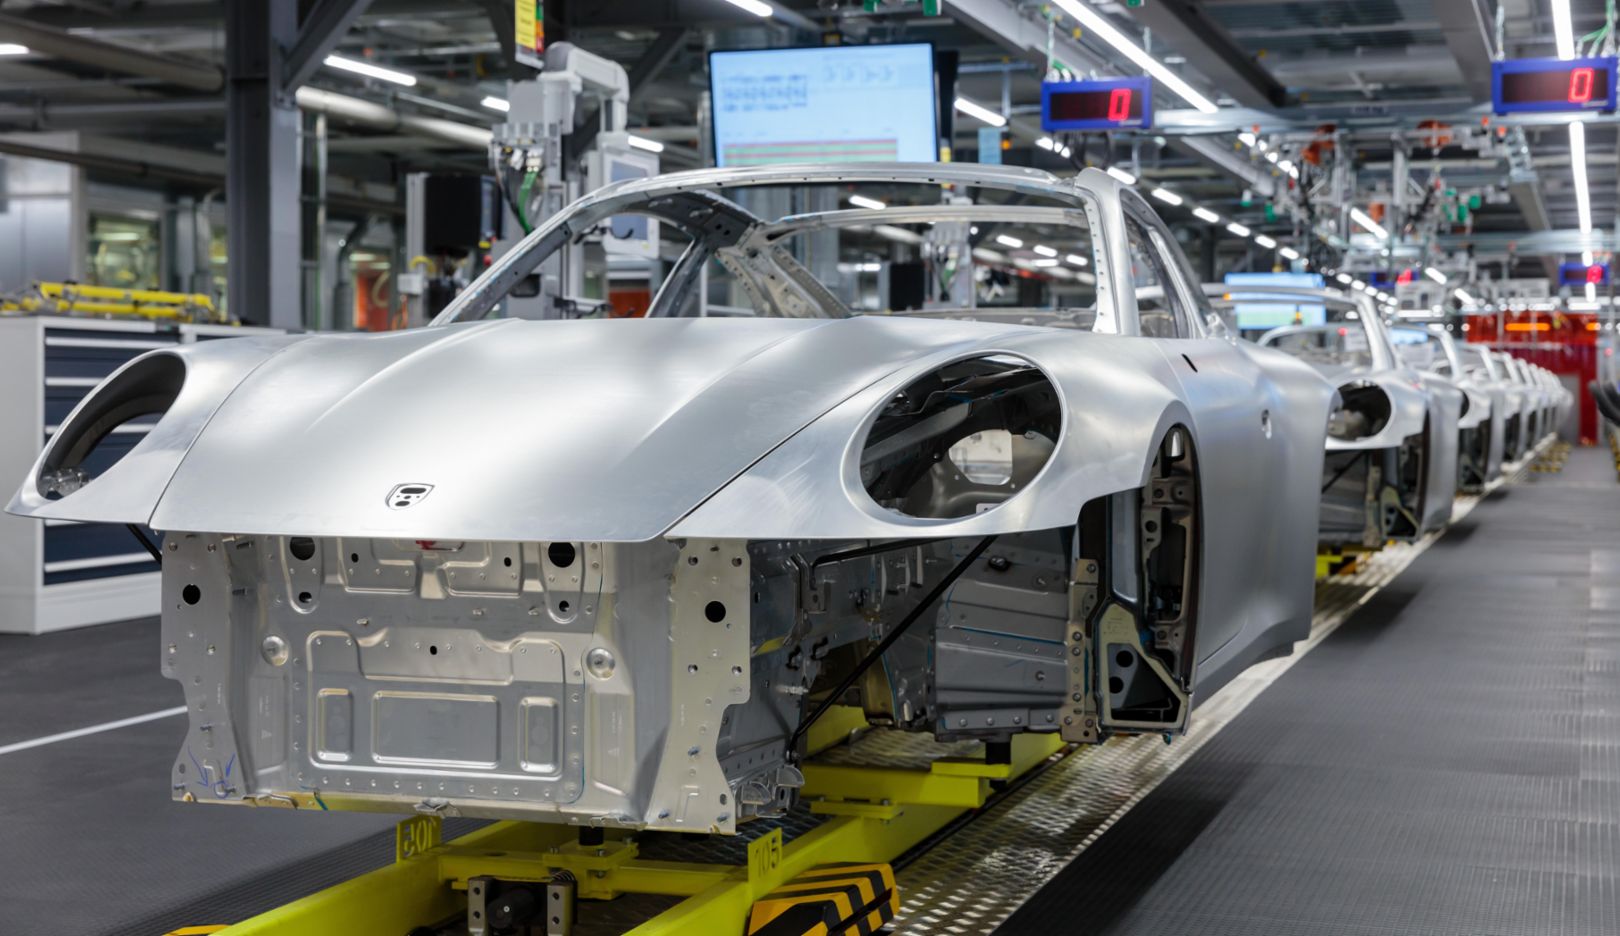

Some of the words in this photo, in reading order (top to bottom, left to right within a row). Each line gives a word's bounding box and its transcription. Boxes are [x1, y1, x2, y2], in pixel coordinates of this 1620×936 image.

[1568, 68, 1594, 103] 0
[1108, 88, 1132, 121] 0
[754, 837, 780, 878] 105
